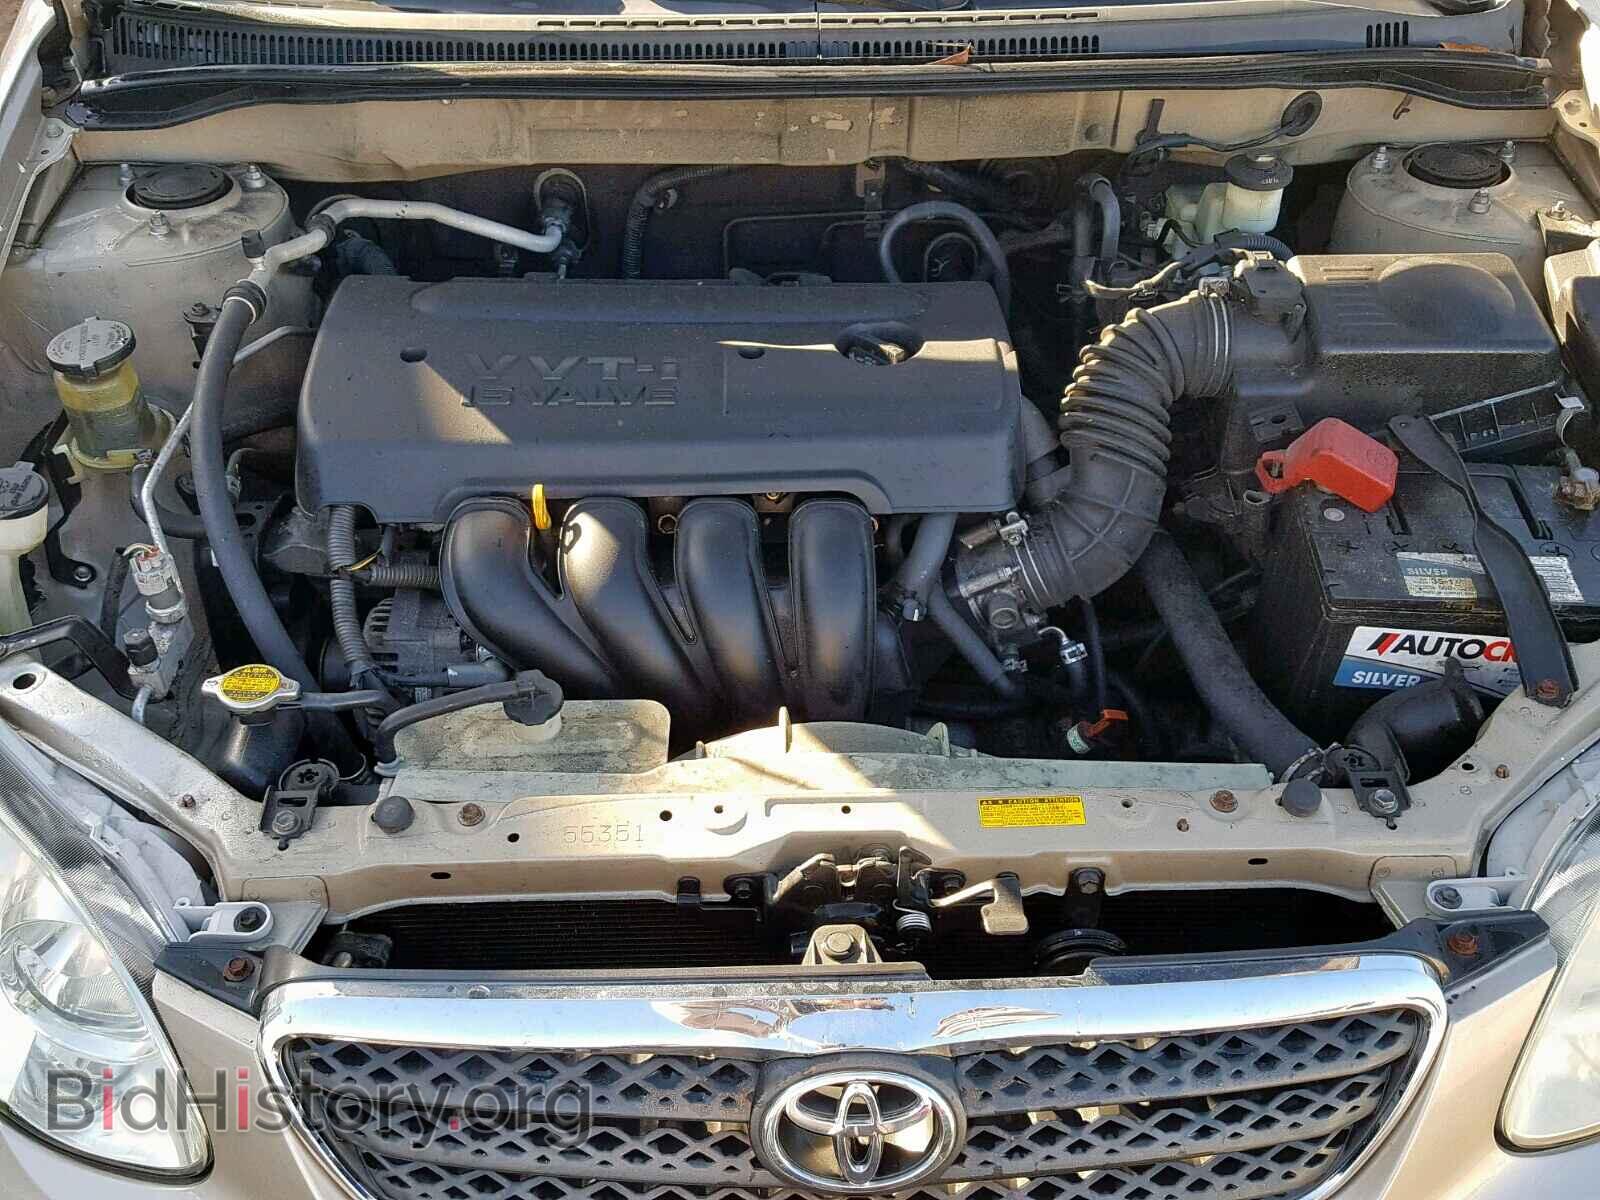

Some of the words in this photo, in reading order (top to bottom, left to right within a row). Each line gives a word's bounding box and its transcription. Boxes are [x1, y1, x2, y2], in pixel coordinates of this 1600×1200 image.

[526, 384, 678, 407] VALVE
[1406, 567, 1449, 577] SILVER
[1351, 670, 1421, 688] SILVER
